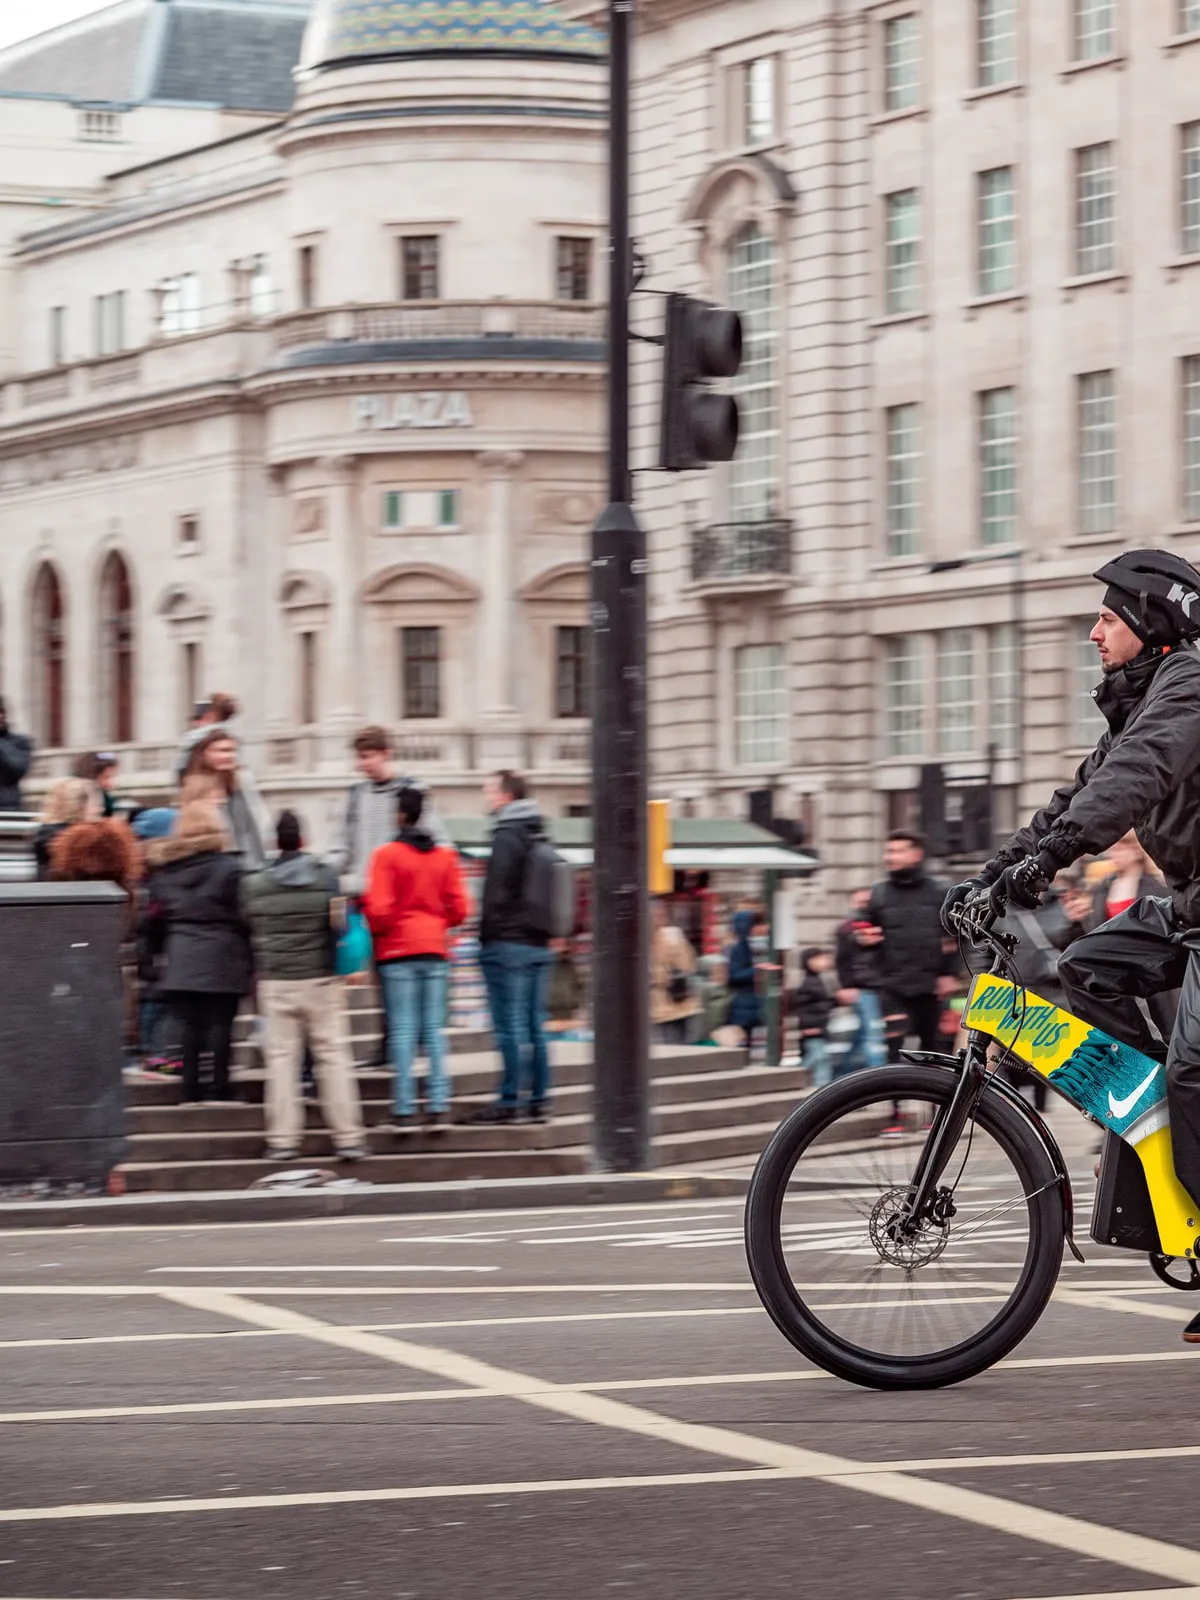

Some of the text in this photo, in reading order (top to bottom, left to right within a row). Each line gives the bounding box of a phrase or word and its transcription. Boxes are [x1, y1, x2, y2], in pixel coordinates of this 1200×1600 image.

[354, 391, 475, 431] PLAZA
[970, 986, 1023, 1010] RUN
[997, 1006, 1058, 1031] WITH
[1032, 1022, 1071, 1047] US
